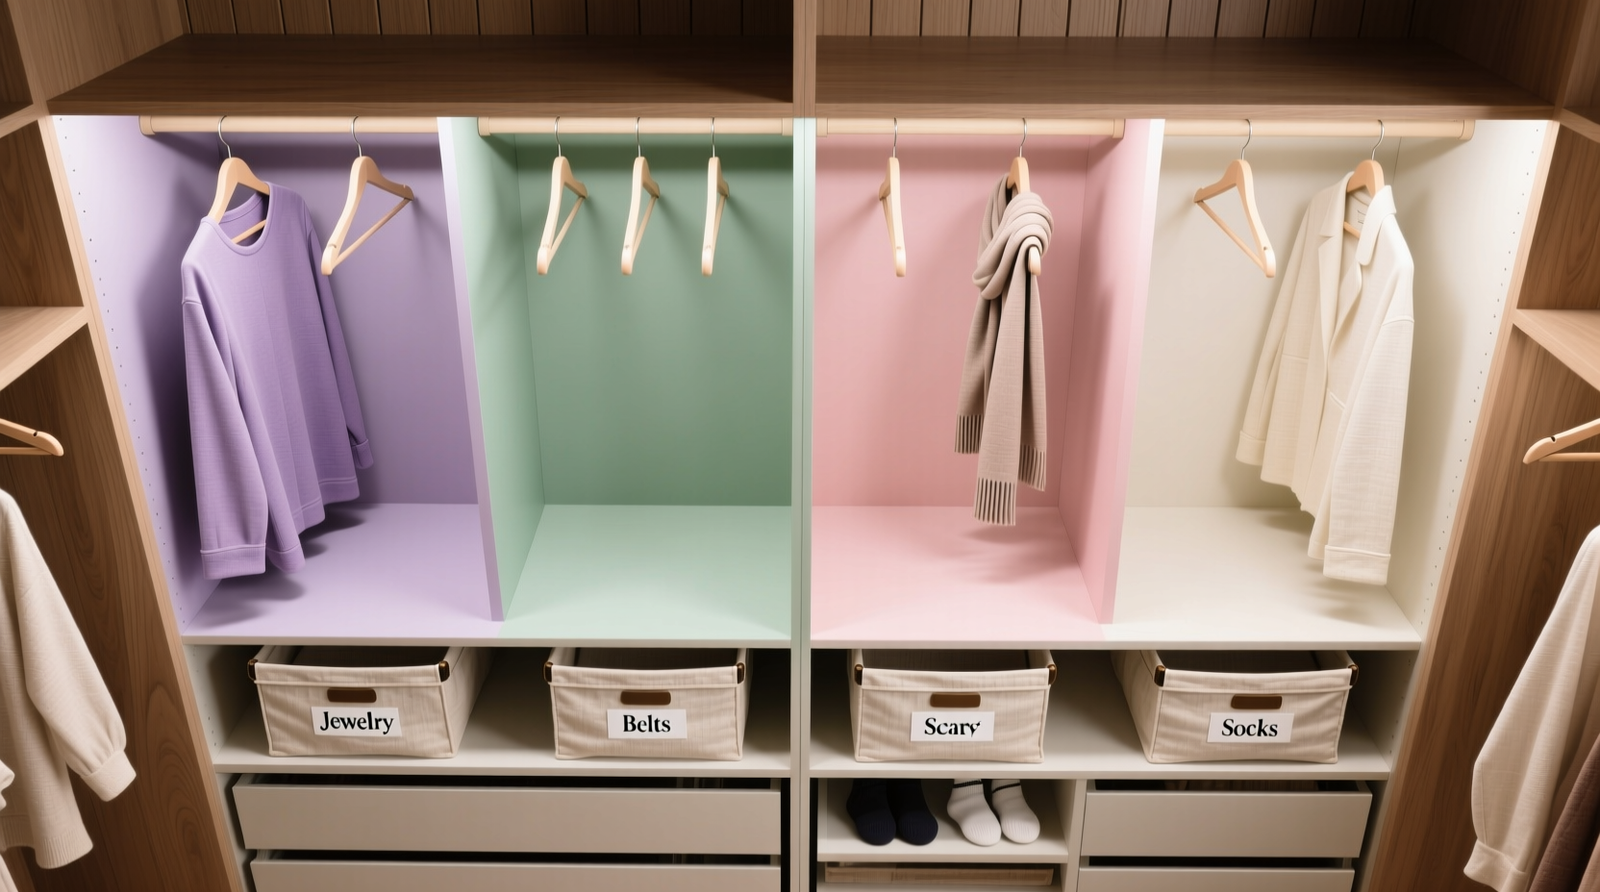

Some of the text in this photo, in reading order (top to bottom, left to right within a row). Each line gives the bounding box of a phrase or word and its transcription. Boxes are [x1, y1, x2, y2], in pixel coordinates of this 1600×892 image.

[320, 711, 394, 735] Jewelry
[623, 714, 671, 733] Belts
[1222, 718, 1278, 737] Socks
